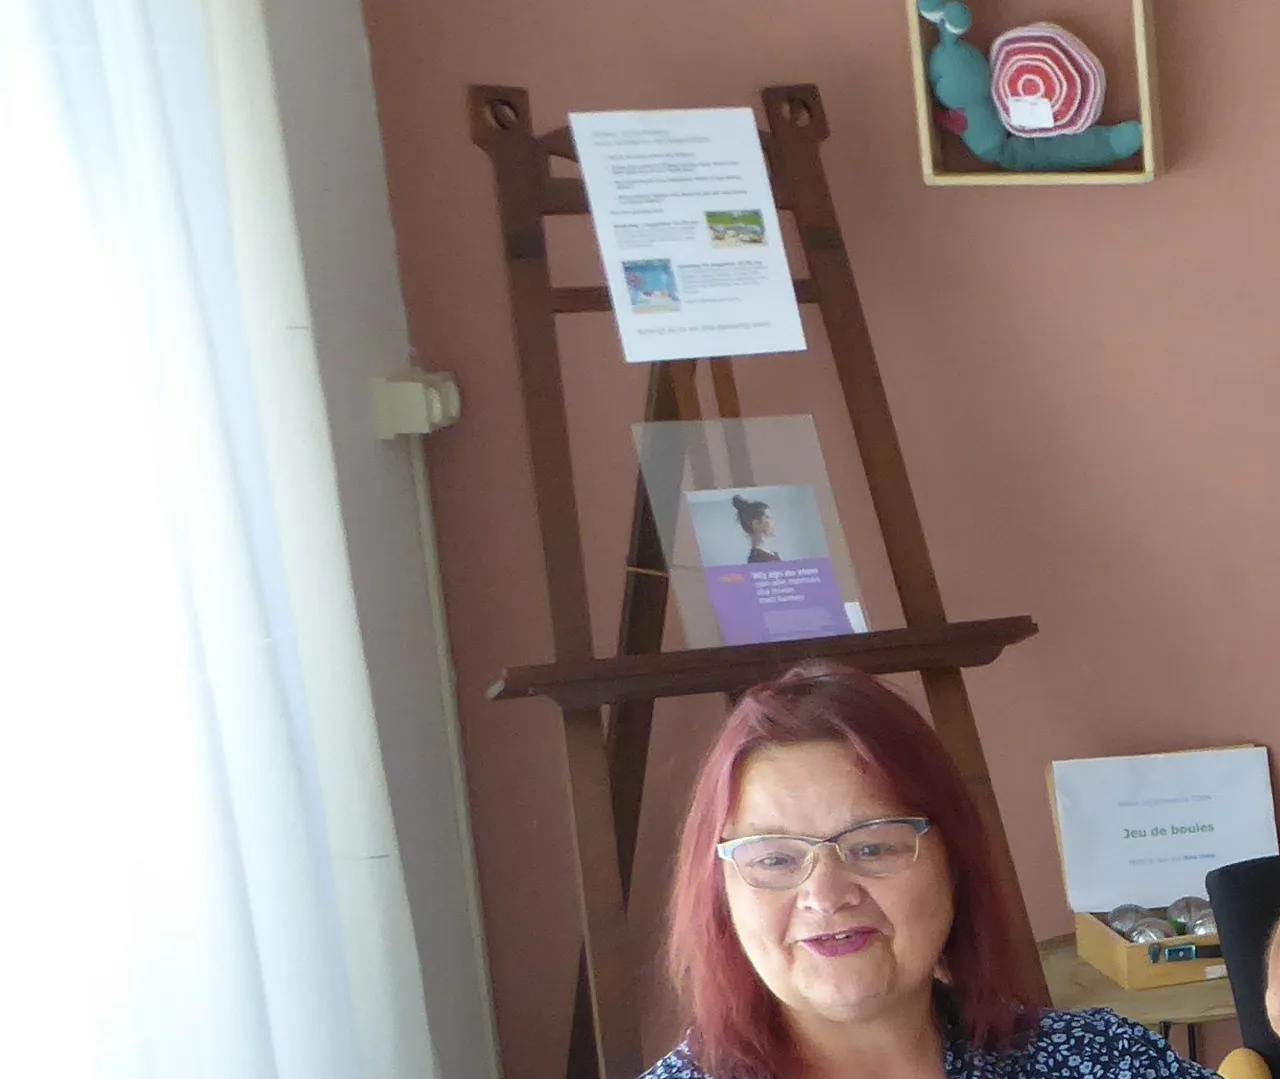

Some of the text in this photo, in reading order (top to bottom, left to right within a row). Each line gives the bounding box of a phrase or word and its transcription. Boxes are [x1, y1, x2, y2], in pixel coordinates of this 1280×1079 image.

[1123, 823, 1215, 839] Jeu de boules
